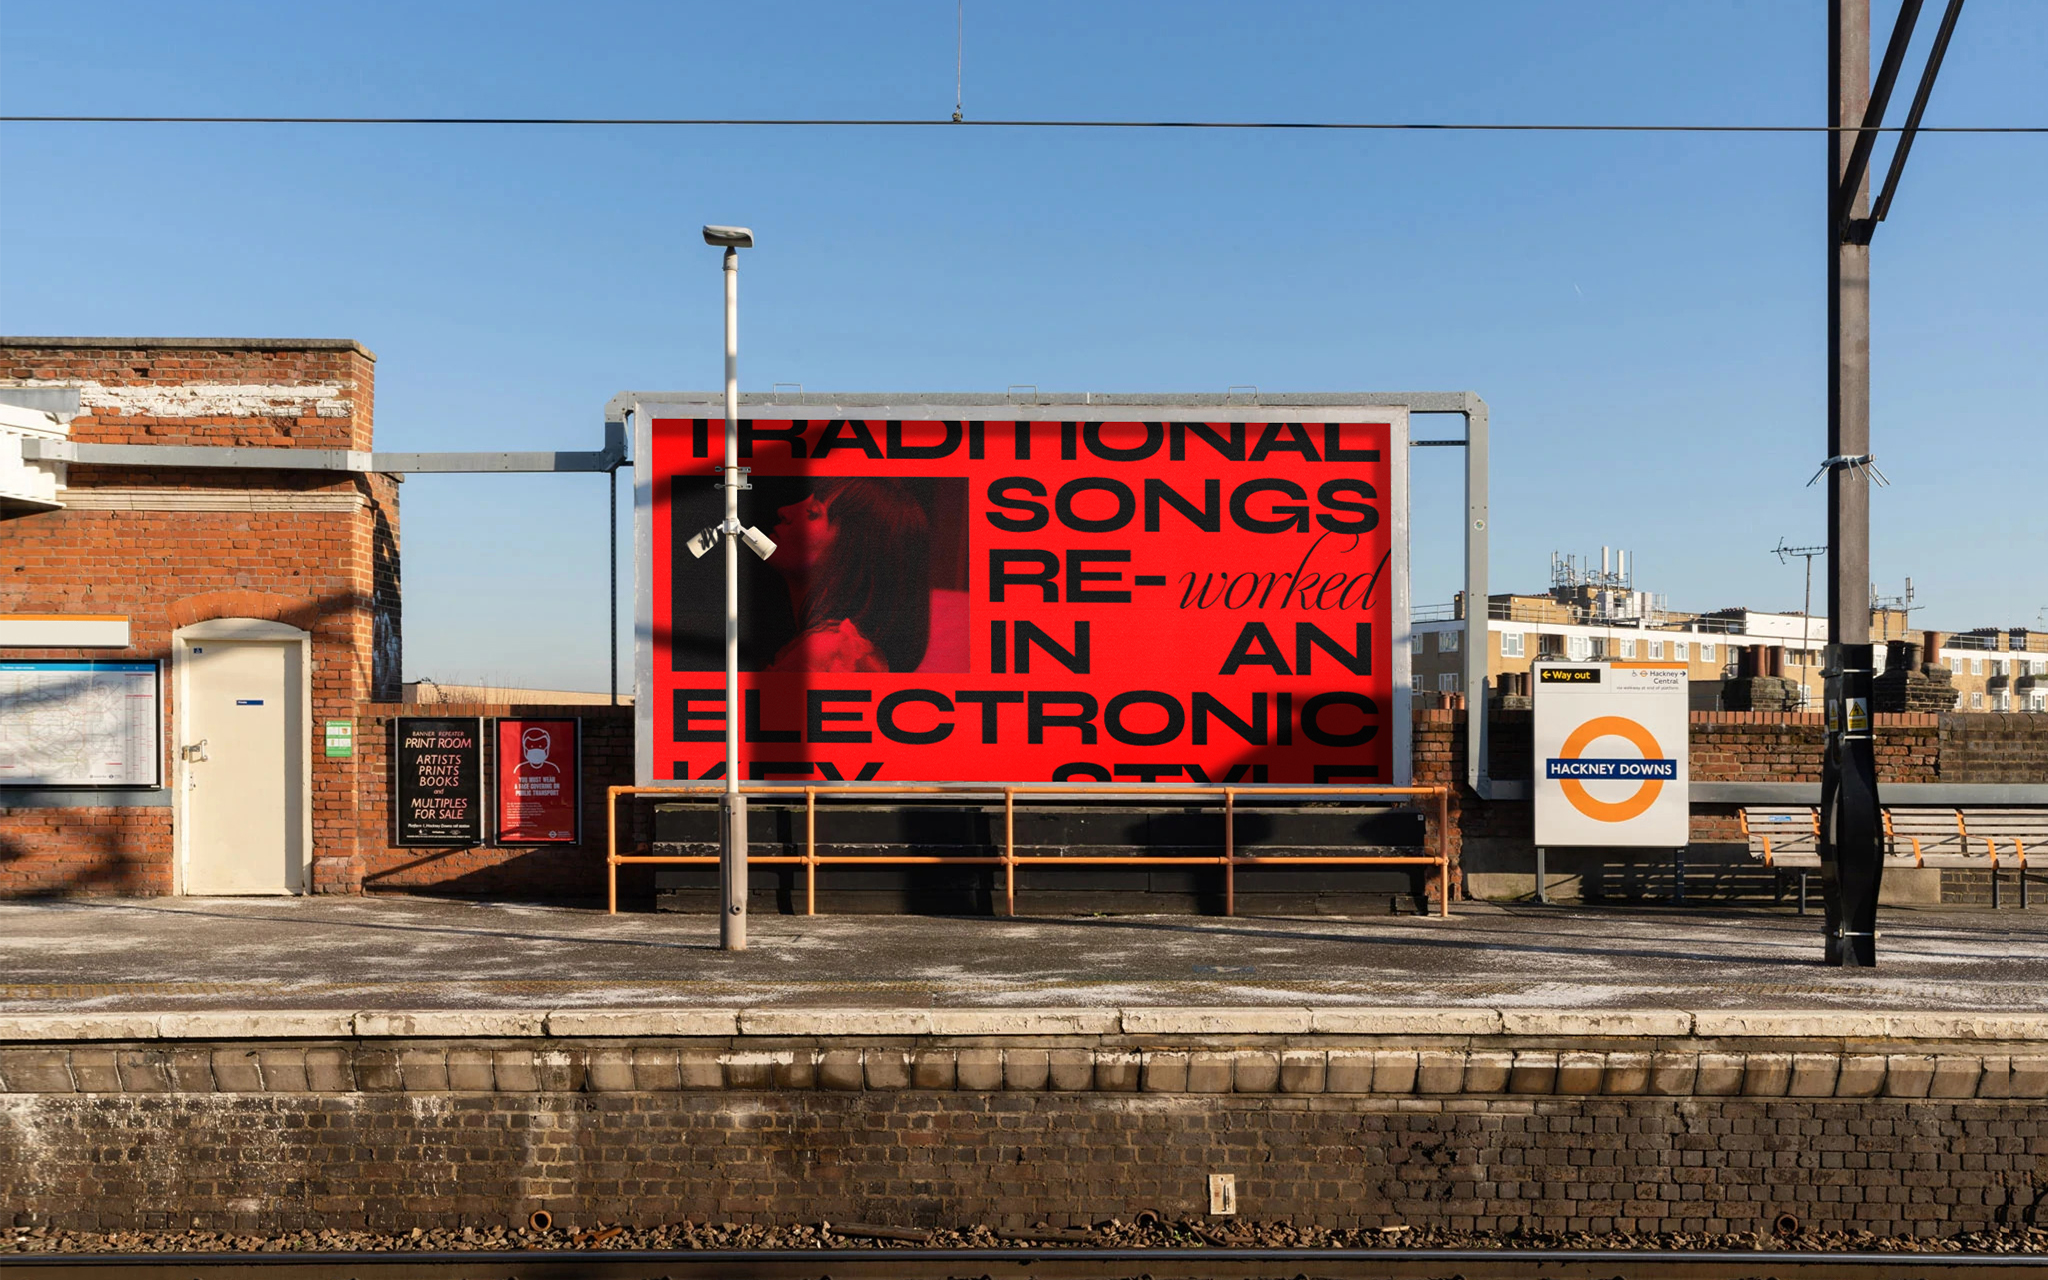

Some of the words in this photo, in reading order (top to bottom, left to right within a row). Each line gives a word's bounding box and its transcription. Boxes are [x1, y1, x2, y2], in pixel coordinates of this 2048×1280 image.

[985, 476, 1380, 535] SONGS
[991, 620, 1090, 674] IN
[1218, 622, 1372, 676] AN
[1552, 671, 1572, 681] Way
[1574, 671, 1591, 680] out
[1650, 670, 1678, 678] Hackney
[673, 688, 1379, 747] ELECTRONIC
[405, 738, 436, 749] PRINT
[437, 738, 472, 749] ROOM
[416, 754, 462, 765] ARTISTS
[418, 765, 460, 776] PRINTS
[1551, 763, 1616, 775] HACKNEY
[1620, 764, 1672, 775] DOWNS
[419, 776, 459, 787] BOOKS
[411, 798, 468, 808] MULTIPLES
[414, 809, 436, 820] FOR
[439, 809, 464, 820] SALE
